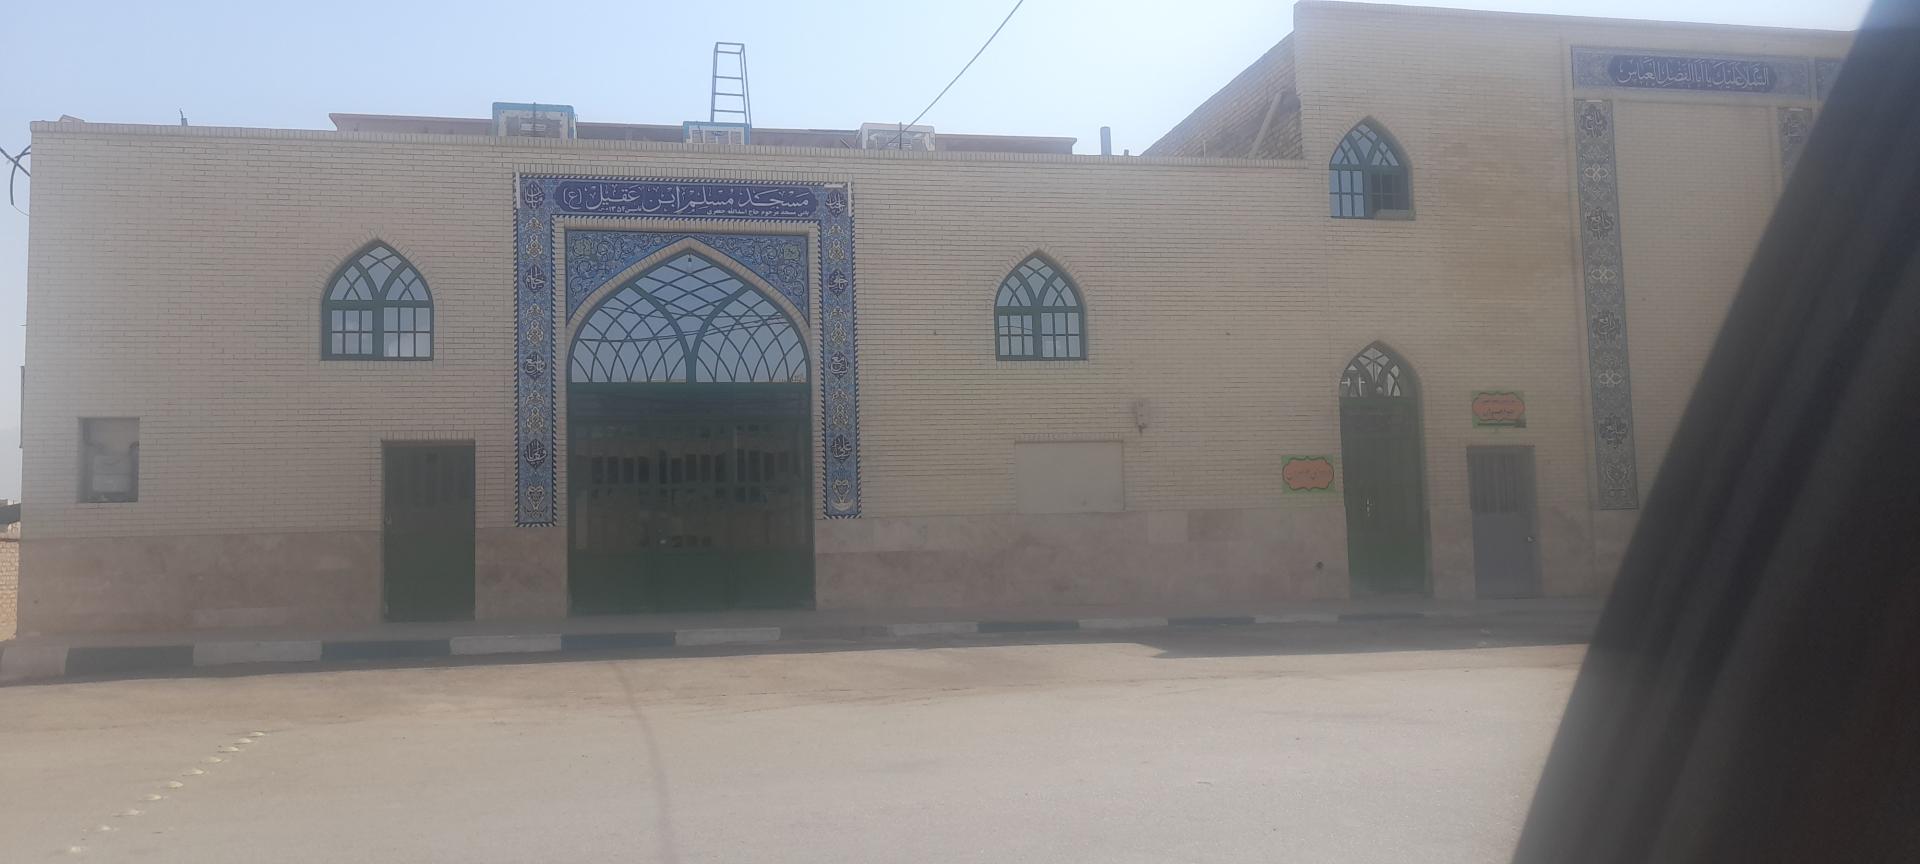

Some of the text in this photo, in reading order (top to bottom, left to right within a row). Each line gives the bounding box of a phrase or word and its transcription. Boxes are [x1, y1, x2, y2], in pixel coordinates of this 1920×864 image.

[563, 188, 583, 209] (ع)
[585, 184, 641, 210] عقیل
[642, 185, 679, 212] ابن
[674, 185, 734, 213] مسلم
[738, 187, 809, 209] مسجد
